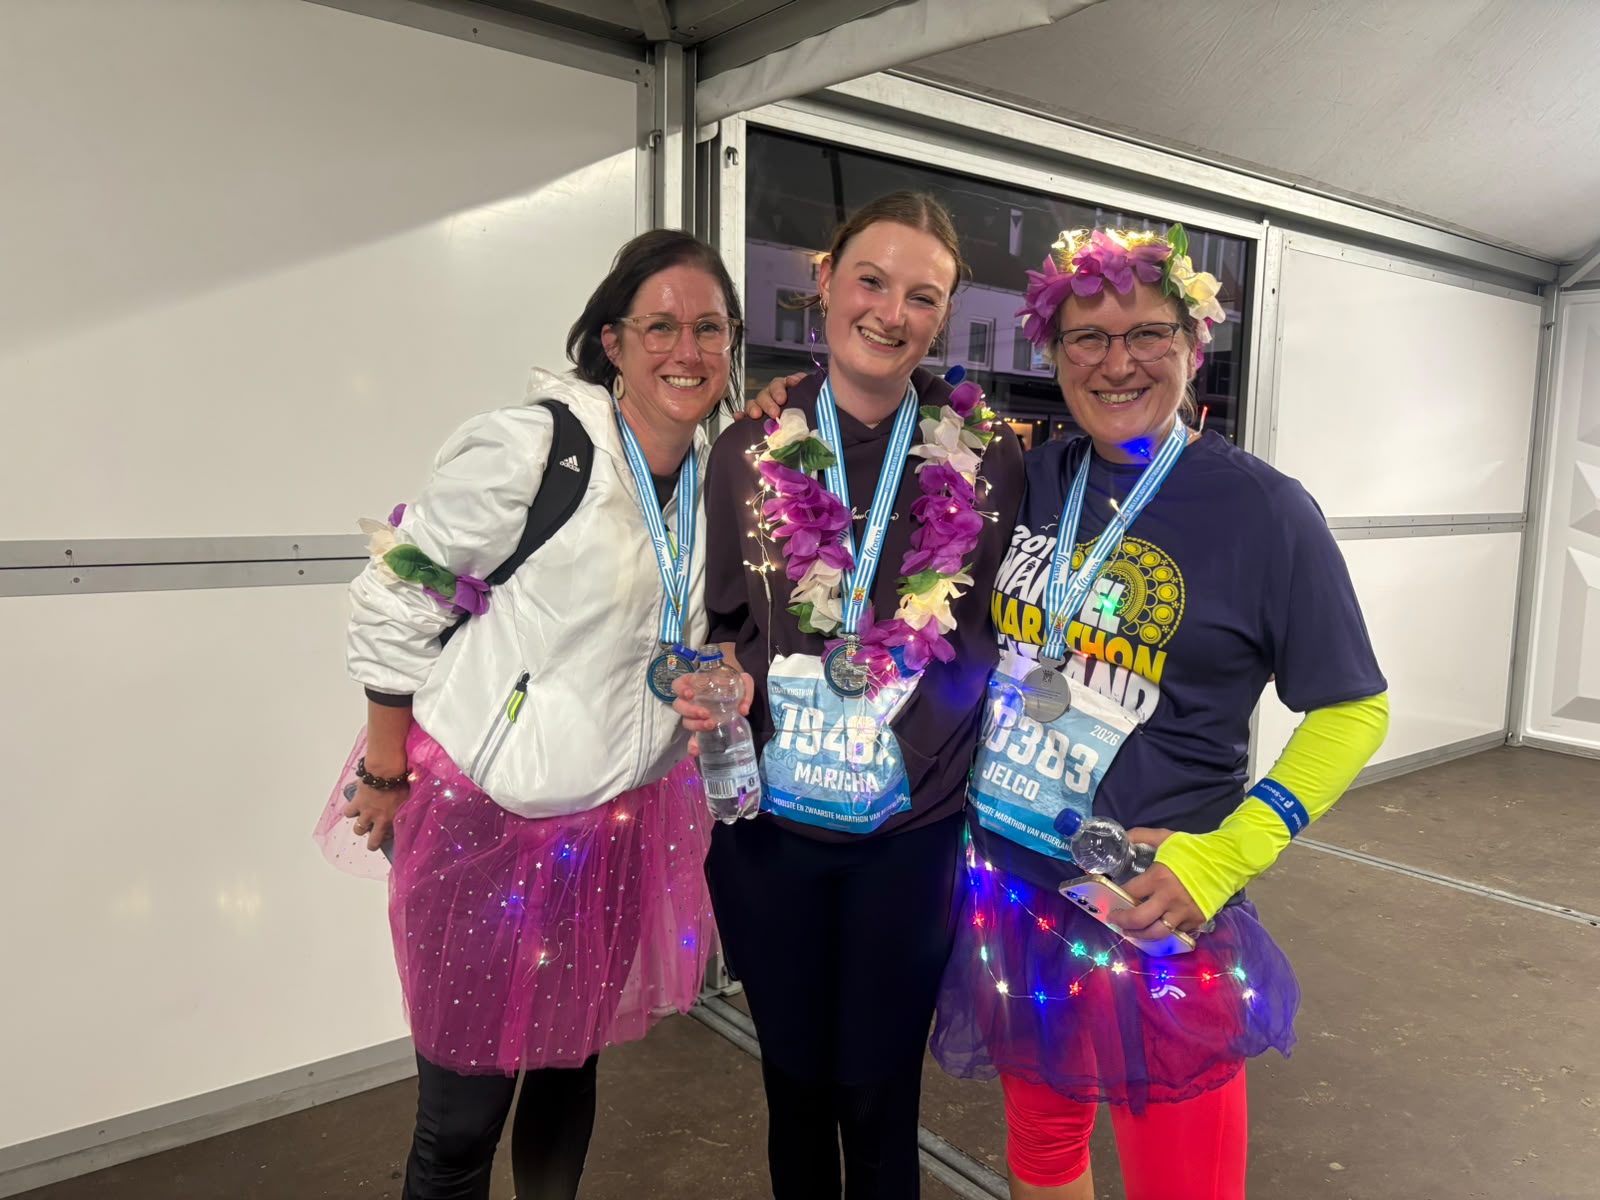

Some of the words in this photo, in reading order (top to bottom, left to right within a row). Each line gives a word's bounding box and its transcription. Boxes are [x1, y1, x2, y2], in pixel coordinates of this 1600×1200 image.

[560, 461, 580, 472] adidas
[873, 530, 882, 547] DELTA
[1011, 524, 1058, 563] 201
[991, 590, 1168, 686] MARTHON
[984, 698, 1099, 794] 0383
[982, 761, 1040, 801] JELCO
[773, 797, 796, 810] MOOISTE
[796, 803, 804, 812] EN
[804, 805, 834, 820] ZWAARSTE
[835, 812, 868, 823] MARATHON
[869, 811, 881, 822] VAN
[994, 810, 1027, 832] MARATHON
[1026, 826, 1041, 839] VAN
